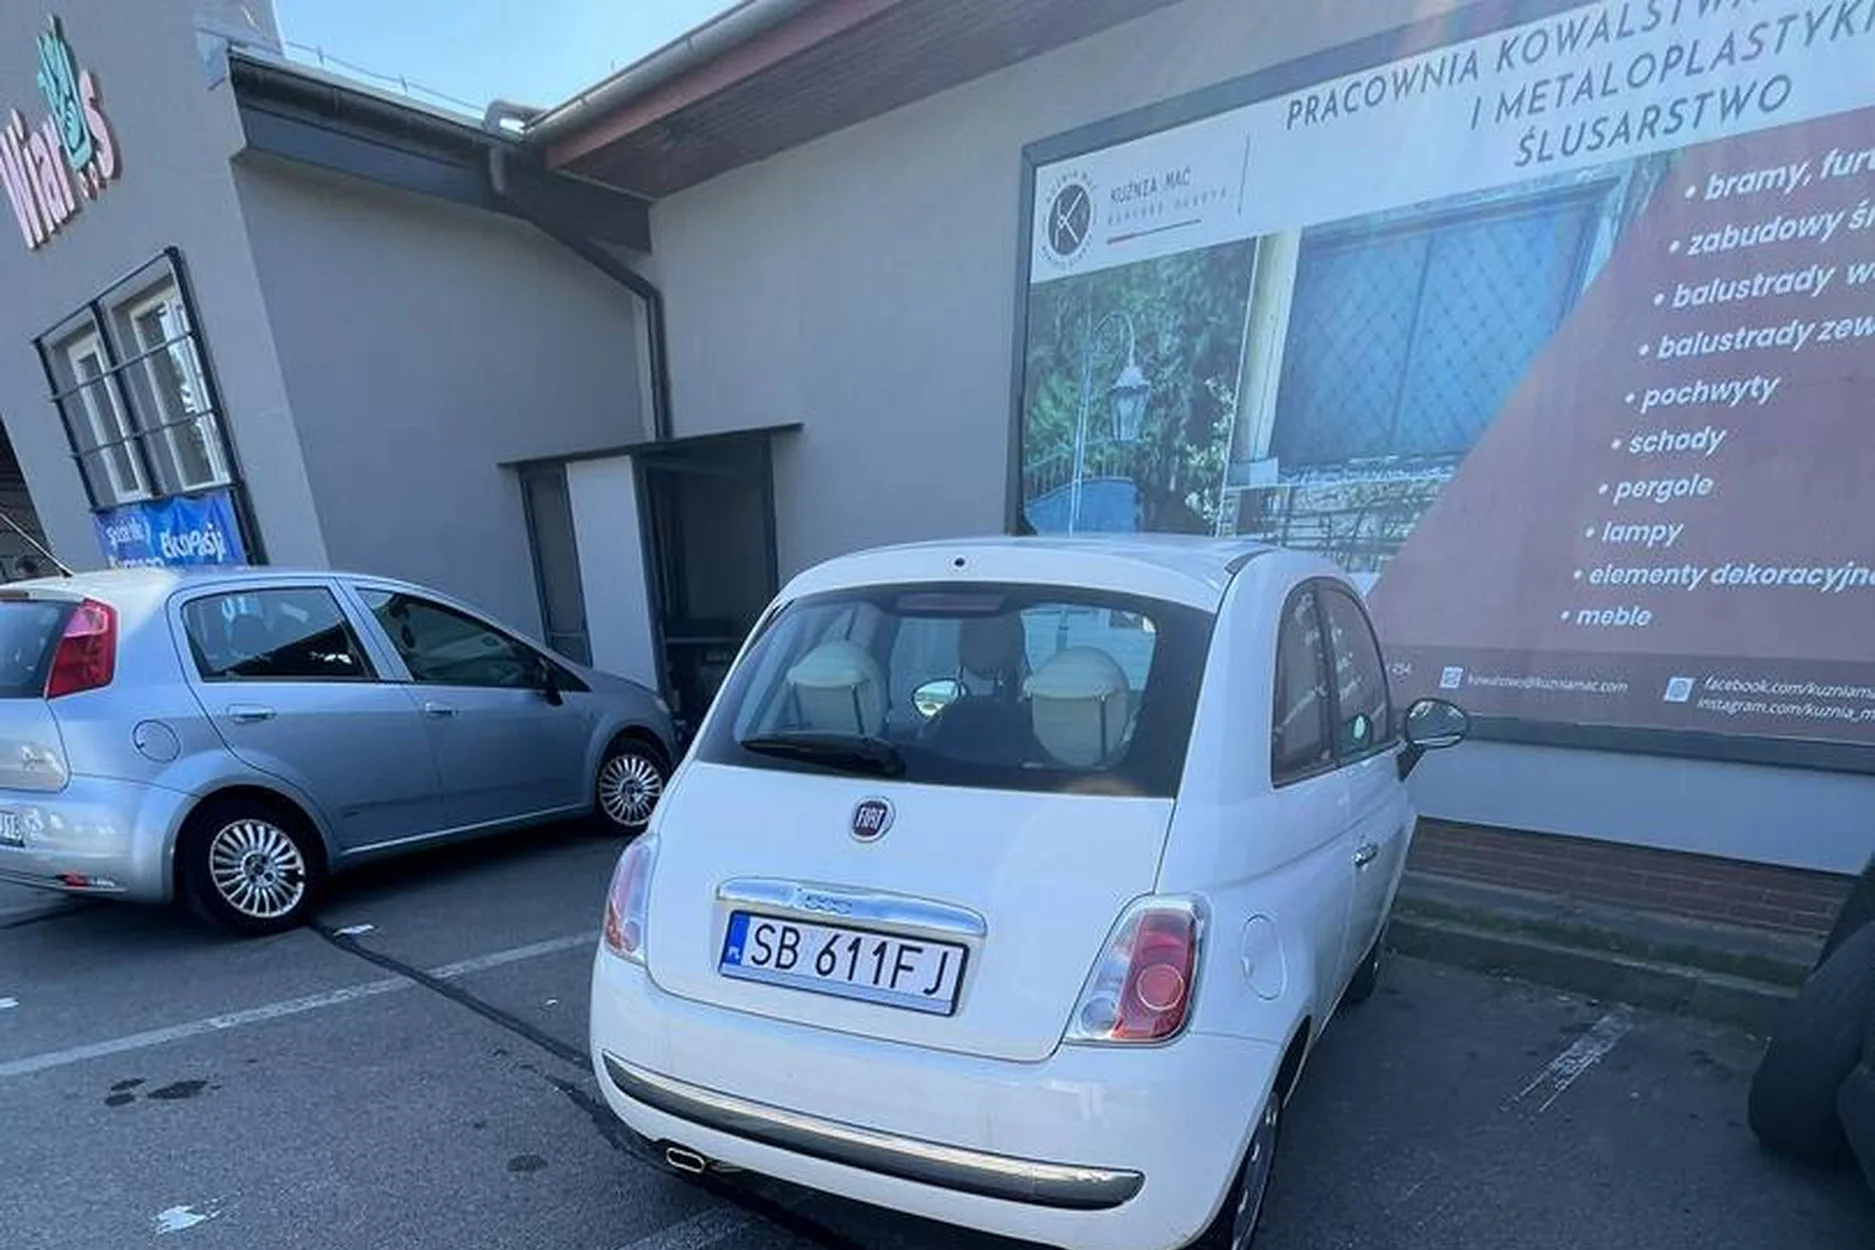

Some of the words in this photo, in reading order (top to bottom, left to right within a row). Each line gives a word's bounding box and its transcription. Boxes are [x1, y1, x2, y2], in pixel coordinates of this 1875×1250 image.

[1287, 50, 1478, 130] PRACOWNIA
[1496, 0, 1744, 72] KOWALST
[1470, 97, 1482, 130] I
[1514, 74, 1793, 167] ŚLUSARSTWO
[1704, 160, 1812, 201] bramy,
[1687, 208, 1846, 255] zabudowy
[1672, 264, 1836, 308] balustrady
[1656, 319, 1816, 359] balustrady
[1641, 375, 1781, 414] pochwyty
[1628, 426, 1726, 458] schody
[1613, 474, 1714, 505] pergole
[1601, 520, 1684, 547] lampy
[1588, 563, 1708, 592] elementy
[1576, 604, 1653, 627] meble
[751, 923, 801, 970] SB
[815, 933, 948, 997] 611FJ
